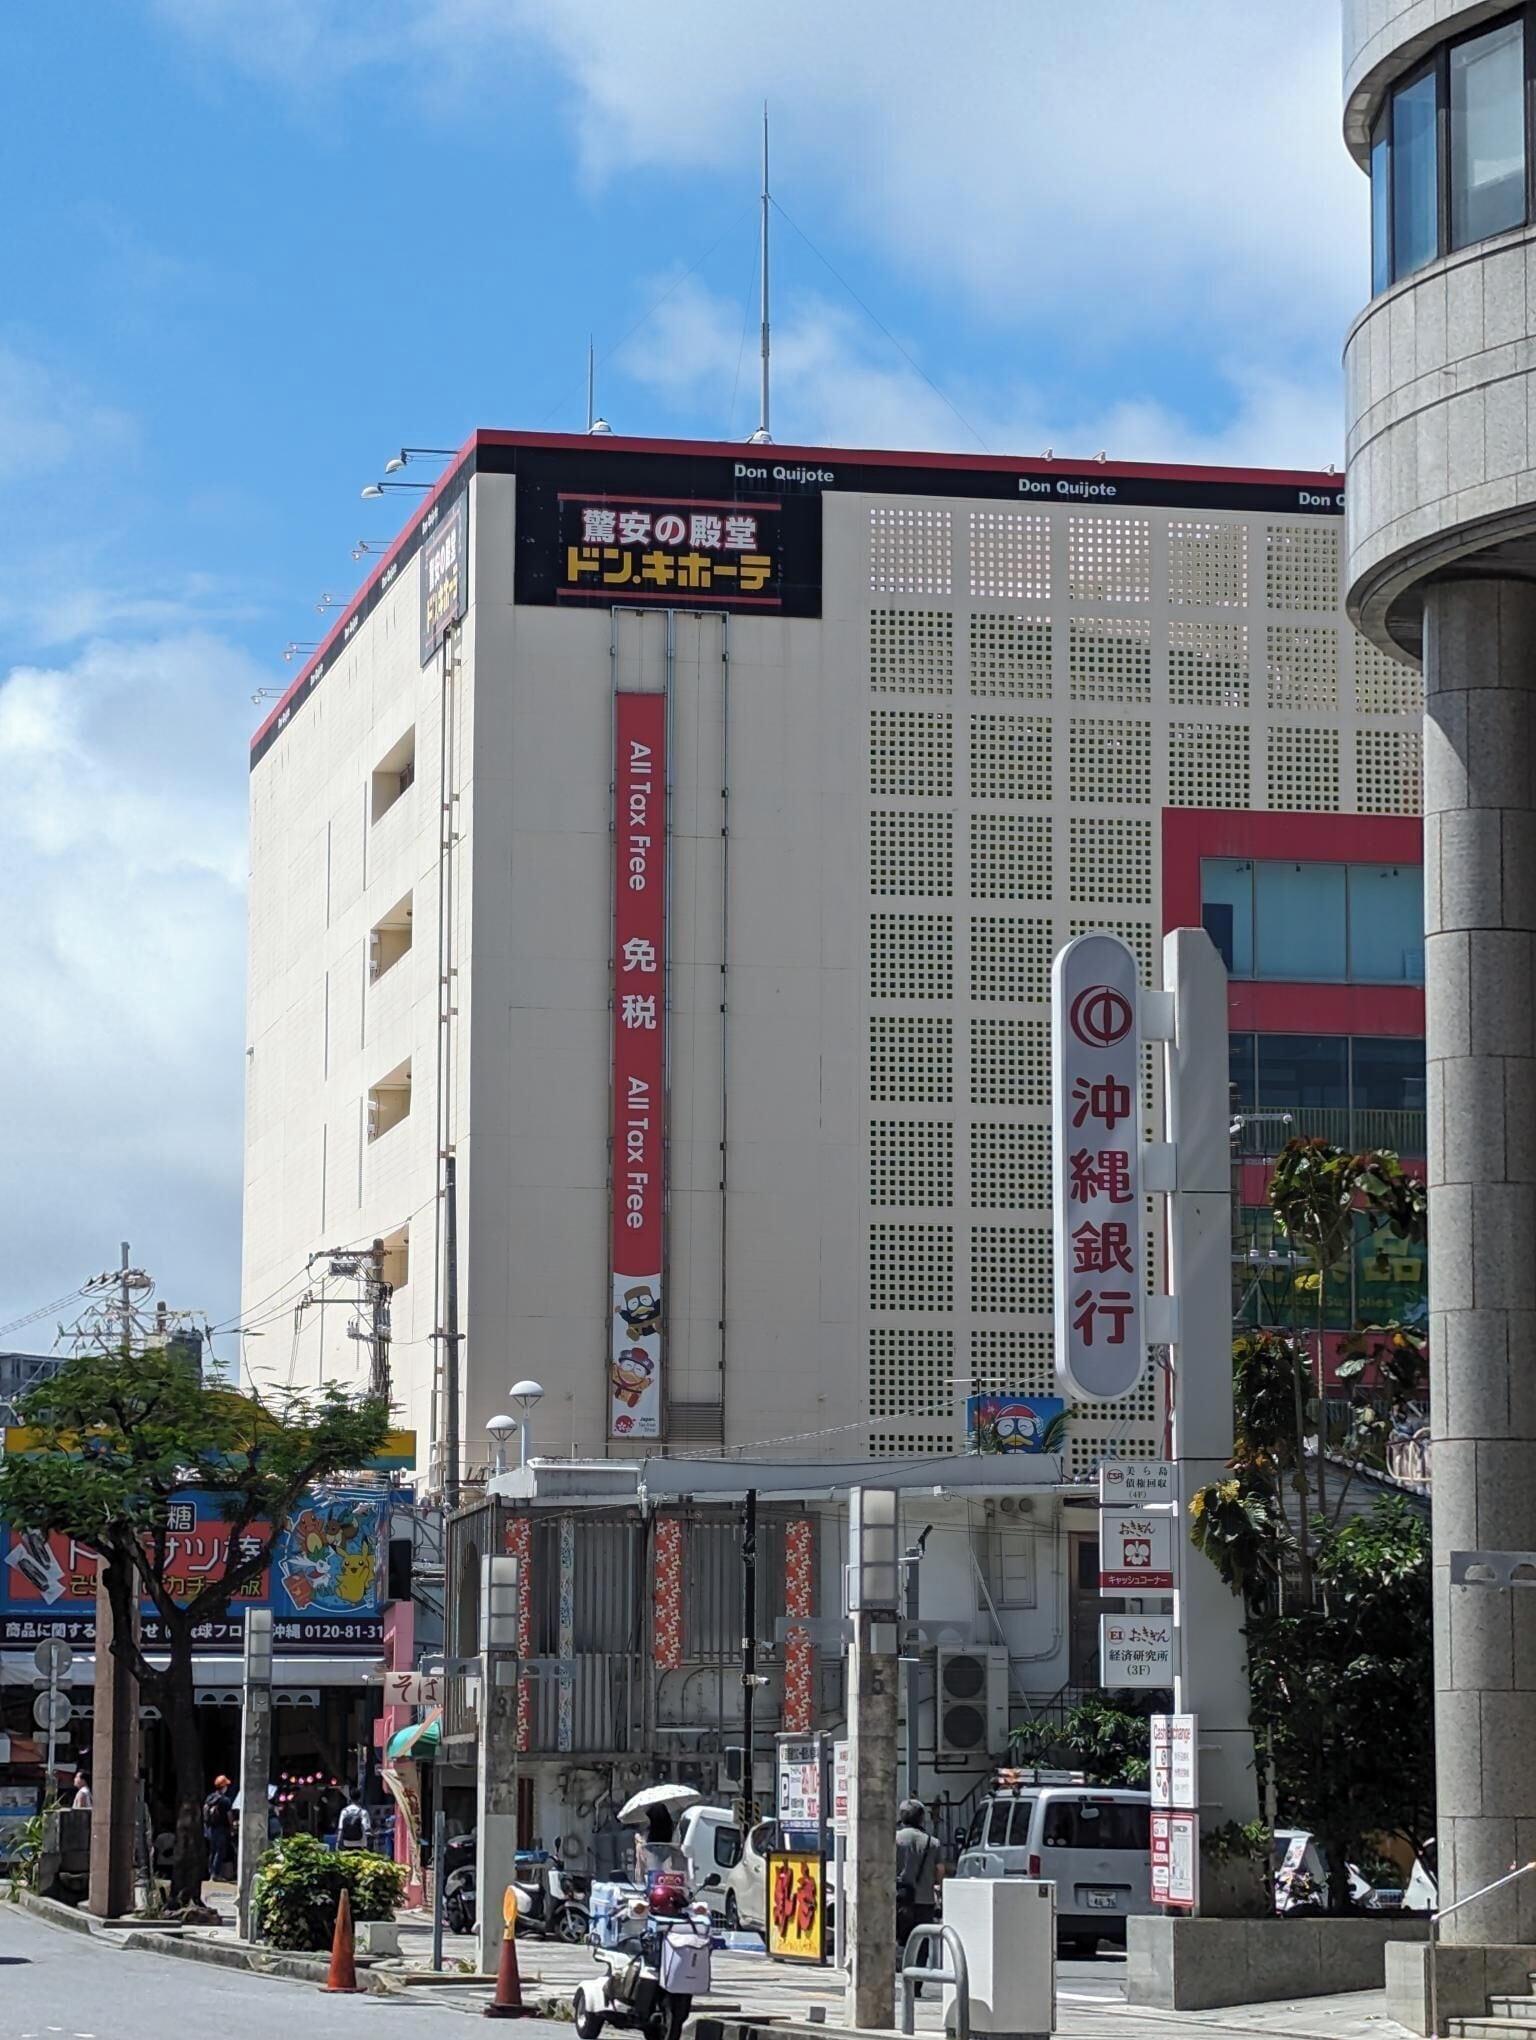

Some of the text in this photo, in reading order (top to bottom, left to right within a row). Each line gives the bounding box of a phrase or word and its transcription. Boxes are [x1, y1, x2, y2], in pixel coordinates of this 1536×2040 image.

[734, 464, 834, 484] Don Quijote
[1018, 478, 1117, 498] Don Quijote
[1298, 491, 1331, 506] Don
[582, 508, 758, 551] 驚安の殿堂
[629, 740, 651, 891] All Tax Free
[622, 937, 657, 1030] 免税
[626, 1076, 650, 1229] All Tax Free
[1069, 1074, 1135, 1347] 沖縄銀行
[166, 1504, 193, 1530] 糖
[1107, 1575, 1168, 1585] キャッシュコーナー
[1109, 1649, 1169, 1662] 経済研究所
[1127, 1664, 1151, 1676] (3F)
[391, 1674, 442, 1703] そば
